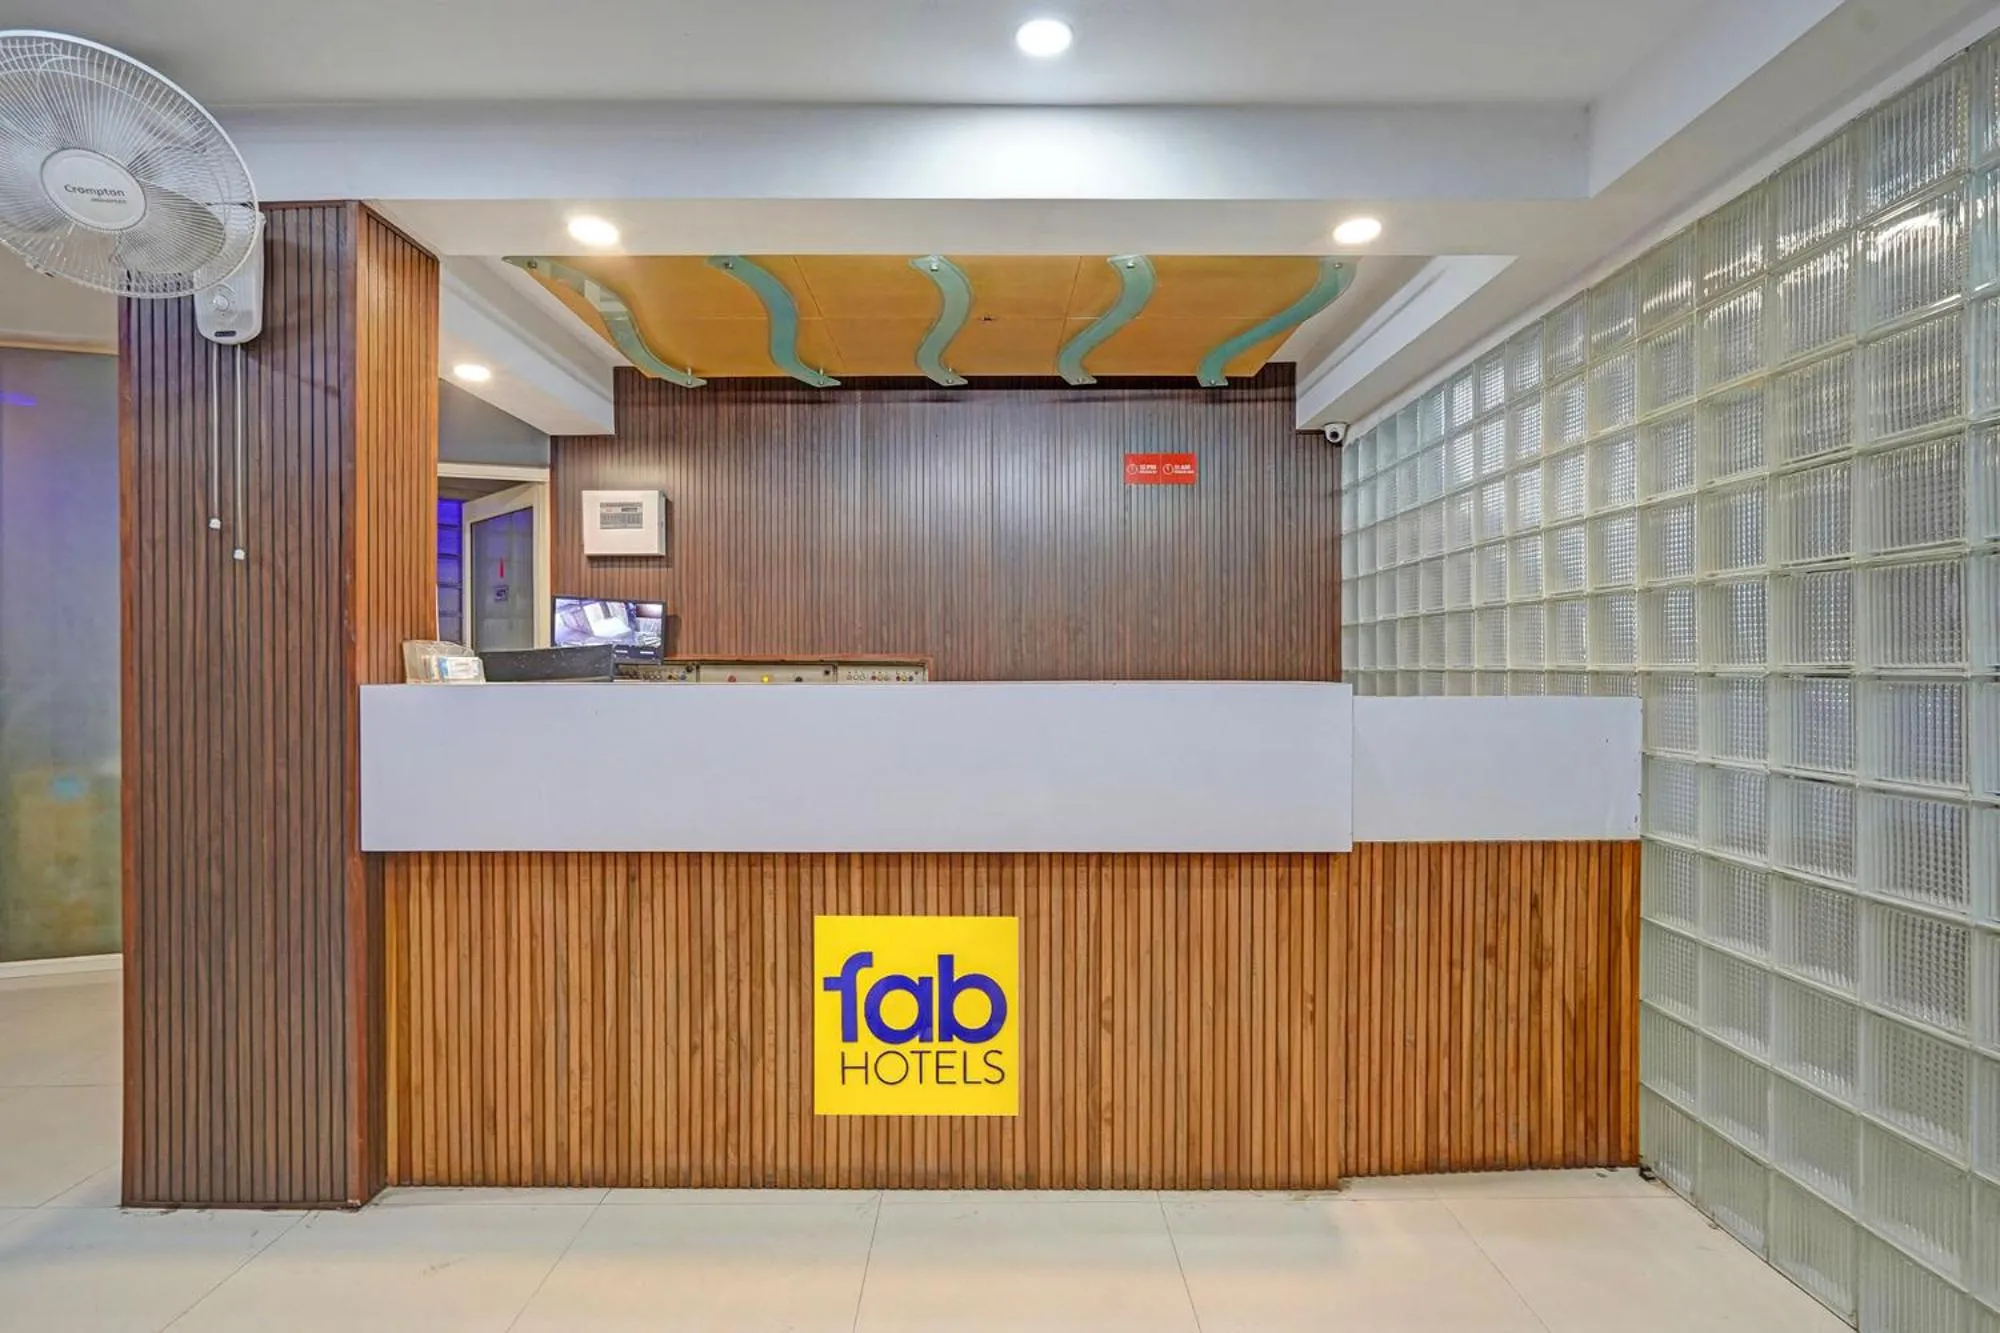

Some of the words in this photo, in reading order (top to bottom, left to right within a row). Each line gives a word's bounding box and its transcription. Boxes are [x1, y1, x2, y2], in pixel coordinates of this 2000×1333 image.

[63, 184, 126, 197] Crompton
[823, 951, 1007, 1045] fab
[841, 1049, 1005, 1085] HOTELS
